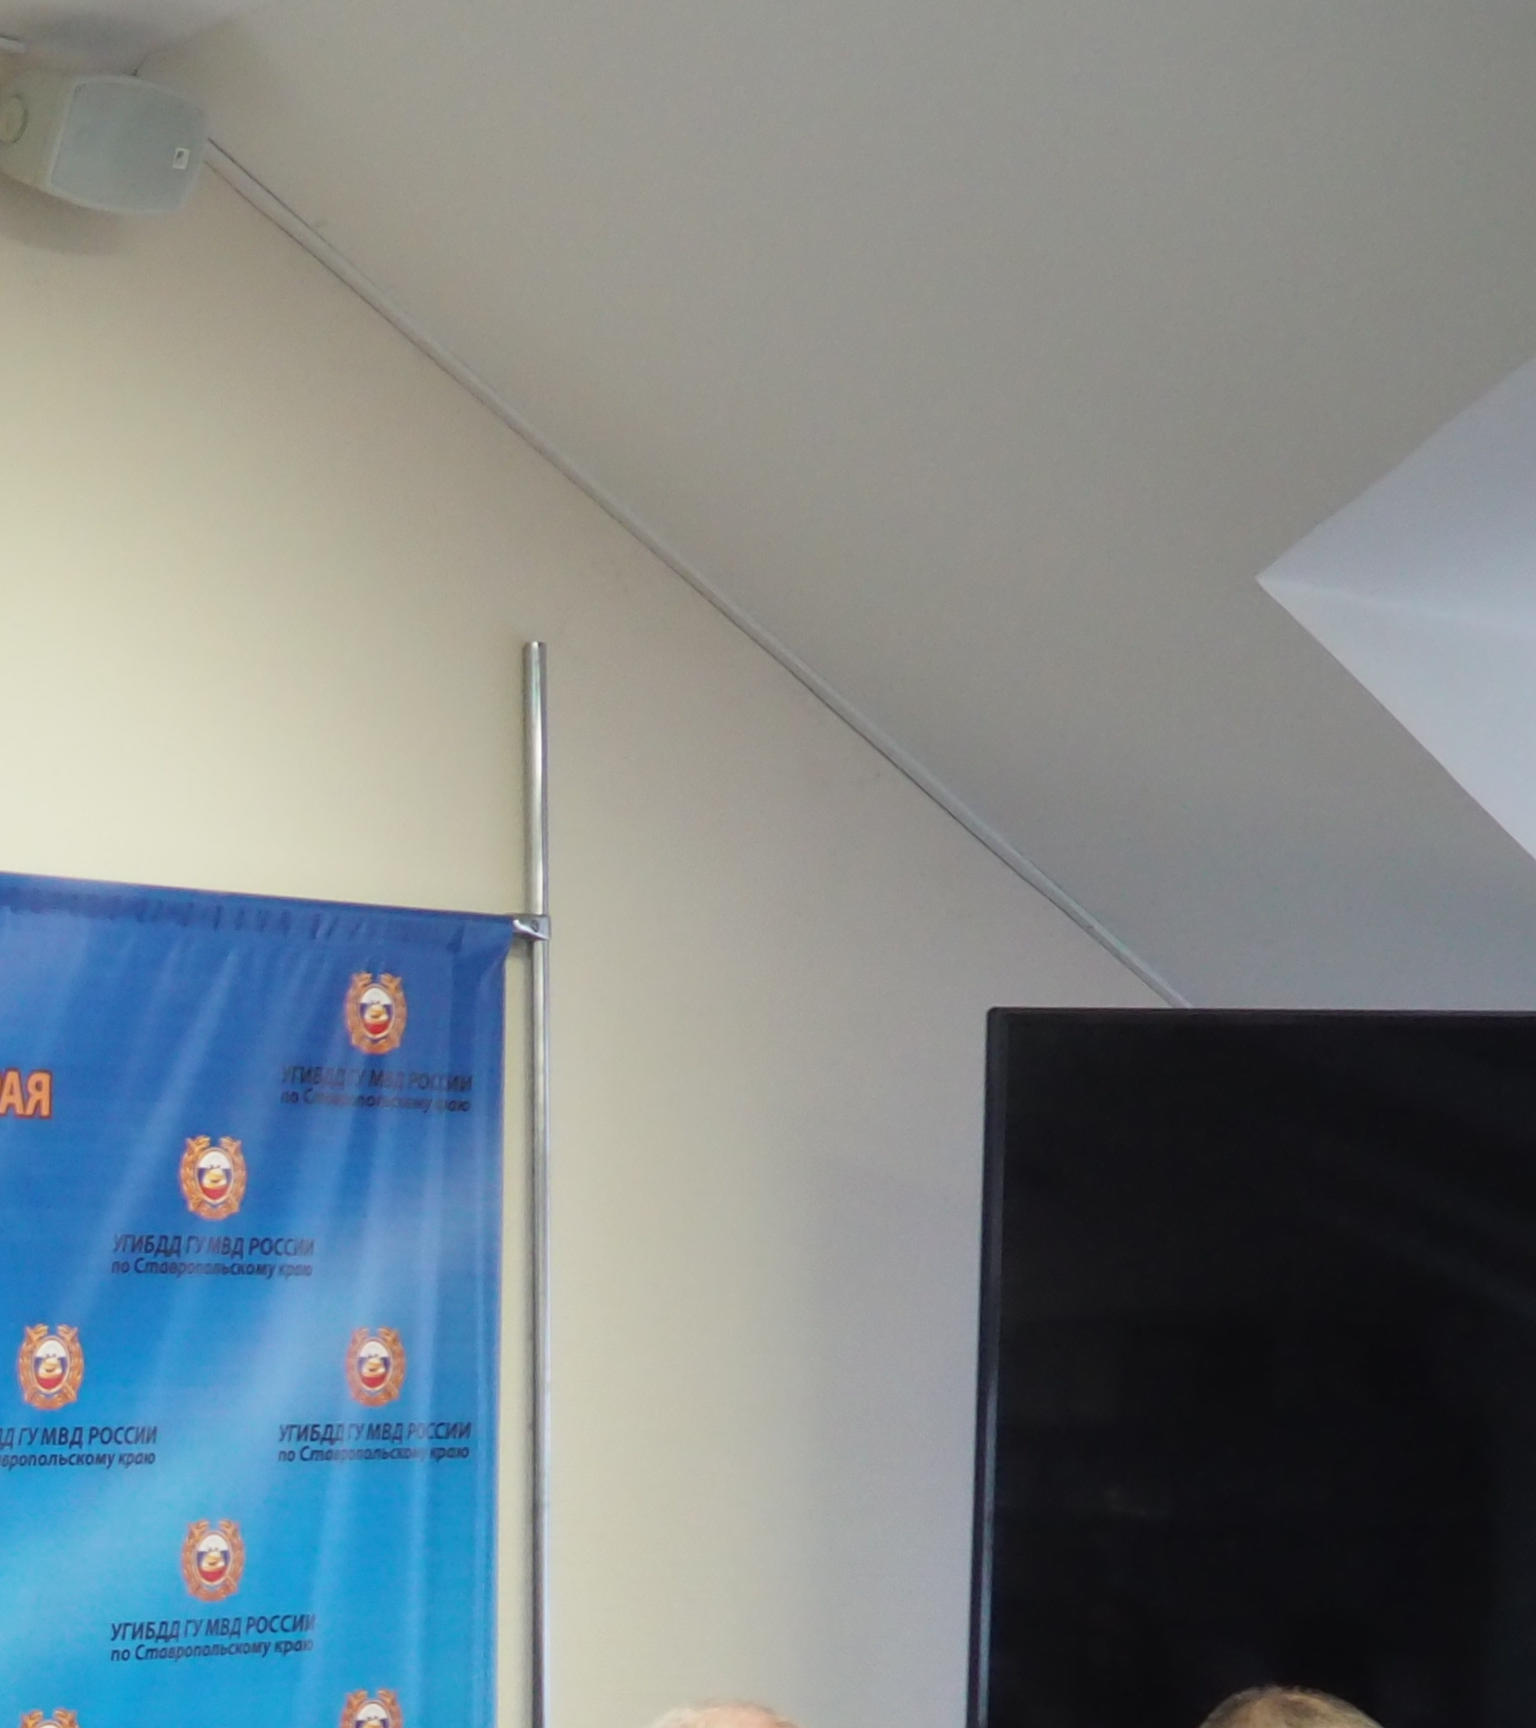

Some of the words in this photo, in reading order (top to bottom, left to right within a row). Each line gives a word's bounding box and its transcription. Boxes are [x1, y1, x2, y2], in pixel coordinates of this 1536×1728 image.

[113, 1234, 183, 1257] УГИБДД
[186, 1236, 205, 1254] ГУ
[208, 1236, 244, 1259] МВД
[248, 1237, 315, 1256] РОССИИ
[18, 1427, 38, 1445] ГУ
[41, 1427, 83, 1449] МВД
[88, 1426, 157, 1445] РОССИИ
[279, 1424, 344, 1445] УГИБДД
[348, 1423, 365, 1440] ГУ
[366, 1423, 403, 1443] МВД
[408, 1422, 472, 1439] РОССИИ
[118, 1452, 156, 1469] краю
[111, 1621, 180, 1643] УГИБДД
[184, 1619, 203, 1638] ГУ
[206, 1617, 241, 1637] МВД
[246, 1614, 315, 1634] РОССИИ
[111, 1648, 130, 1661] по
[135, 1640, 271, 1662] Ставропольскому
[275, 1639, 313, 1657] краю
